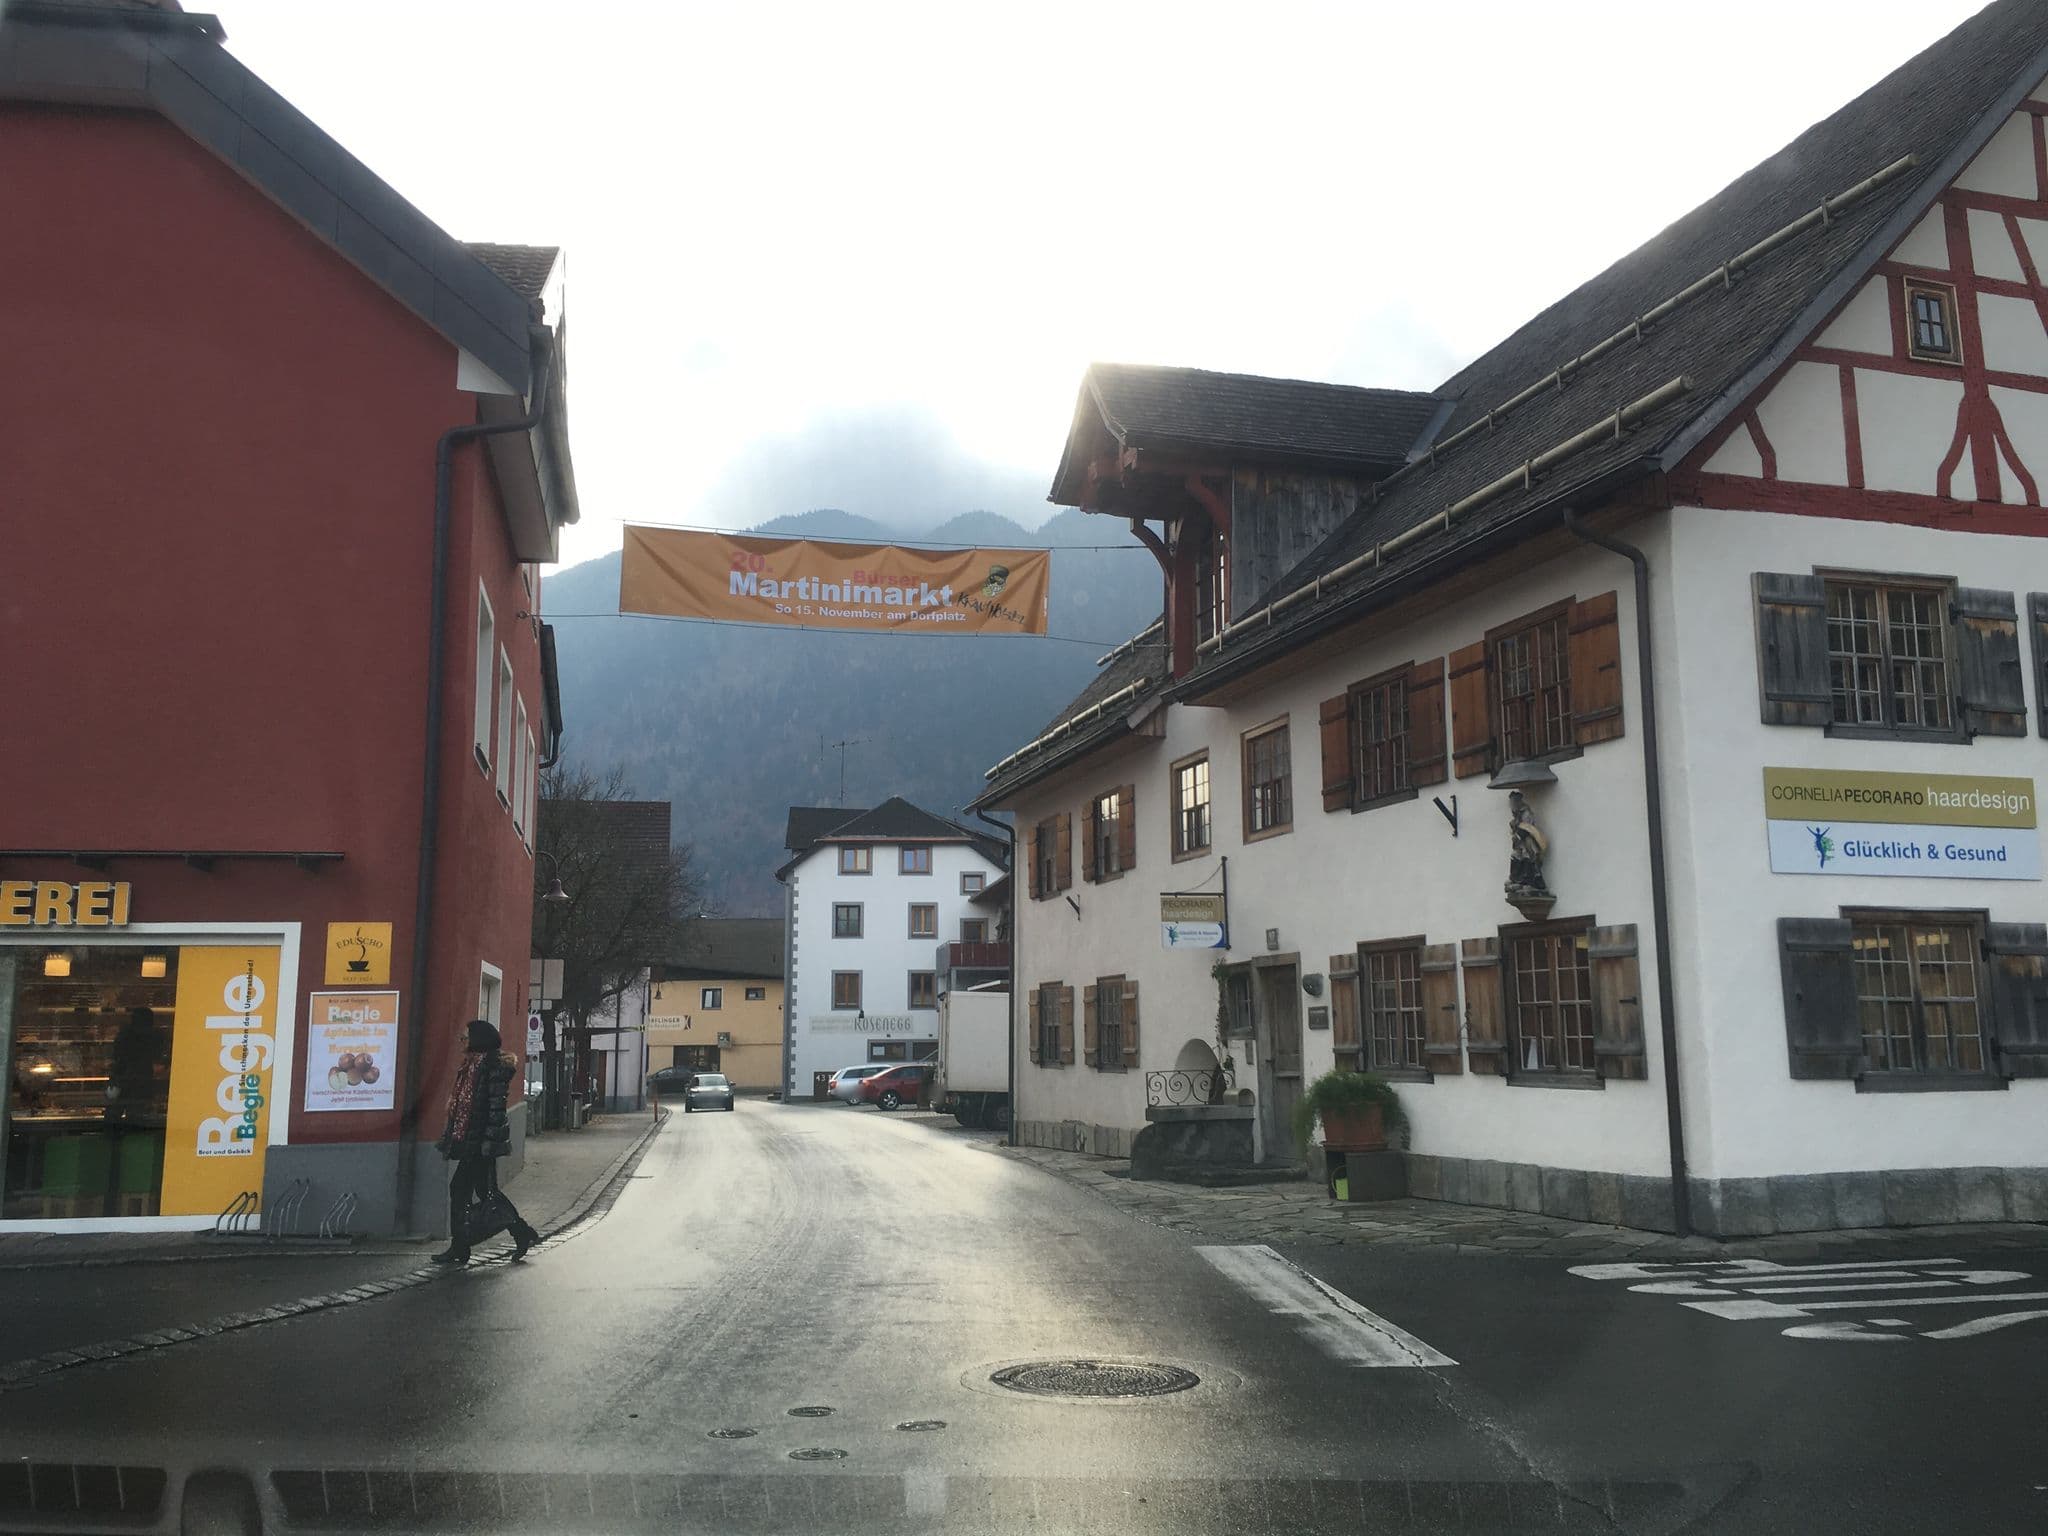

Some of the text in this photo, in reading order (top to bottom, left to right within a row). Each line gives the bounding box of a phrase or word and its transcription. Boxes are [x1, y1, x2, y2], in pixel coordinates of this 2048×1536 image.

[730, 551, 774, 574] 20.
[729, 571, 953, 607] Martinimarkt
[853, 570, 919, 587] Bürser
[775, 603, 967, 623] So 15. November am Dorfplatz
[1927, 787, 2030, 814] haardesign
[1843, 840, 2007, 862] Glücklich & Gesund
[0, 880, 130, 926] EREI
[336, 936, 384, 949] EDUSCHO
[240, 1028, 249, 1071] schmecken
[245, 959, 254, 1009] Unterschied!
[328, 1005, 381, 1024] Begle
[854, 1016, 911, 1032] ROSENEGG
[196, 974, 275, 1156] Begle
[237, 1073, 265, 1139] Begle
